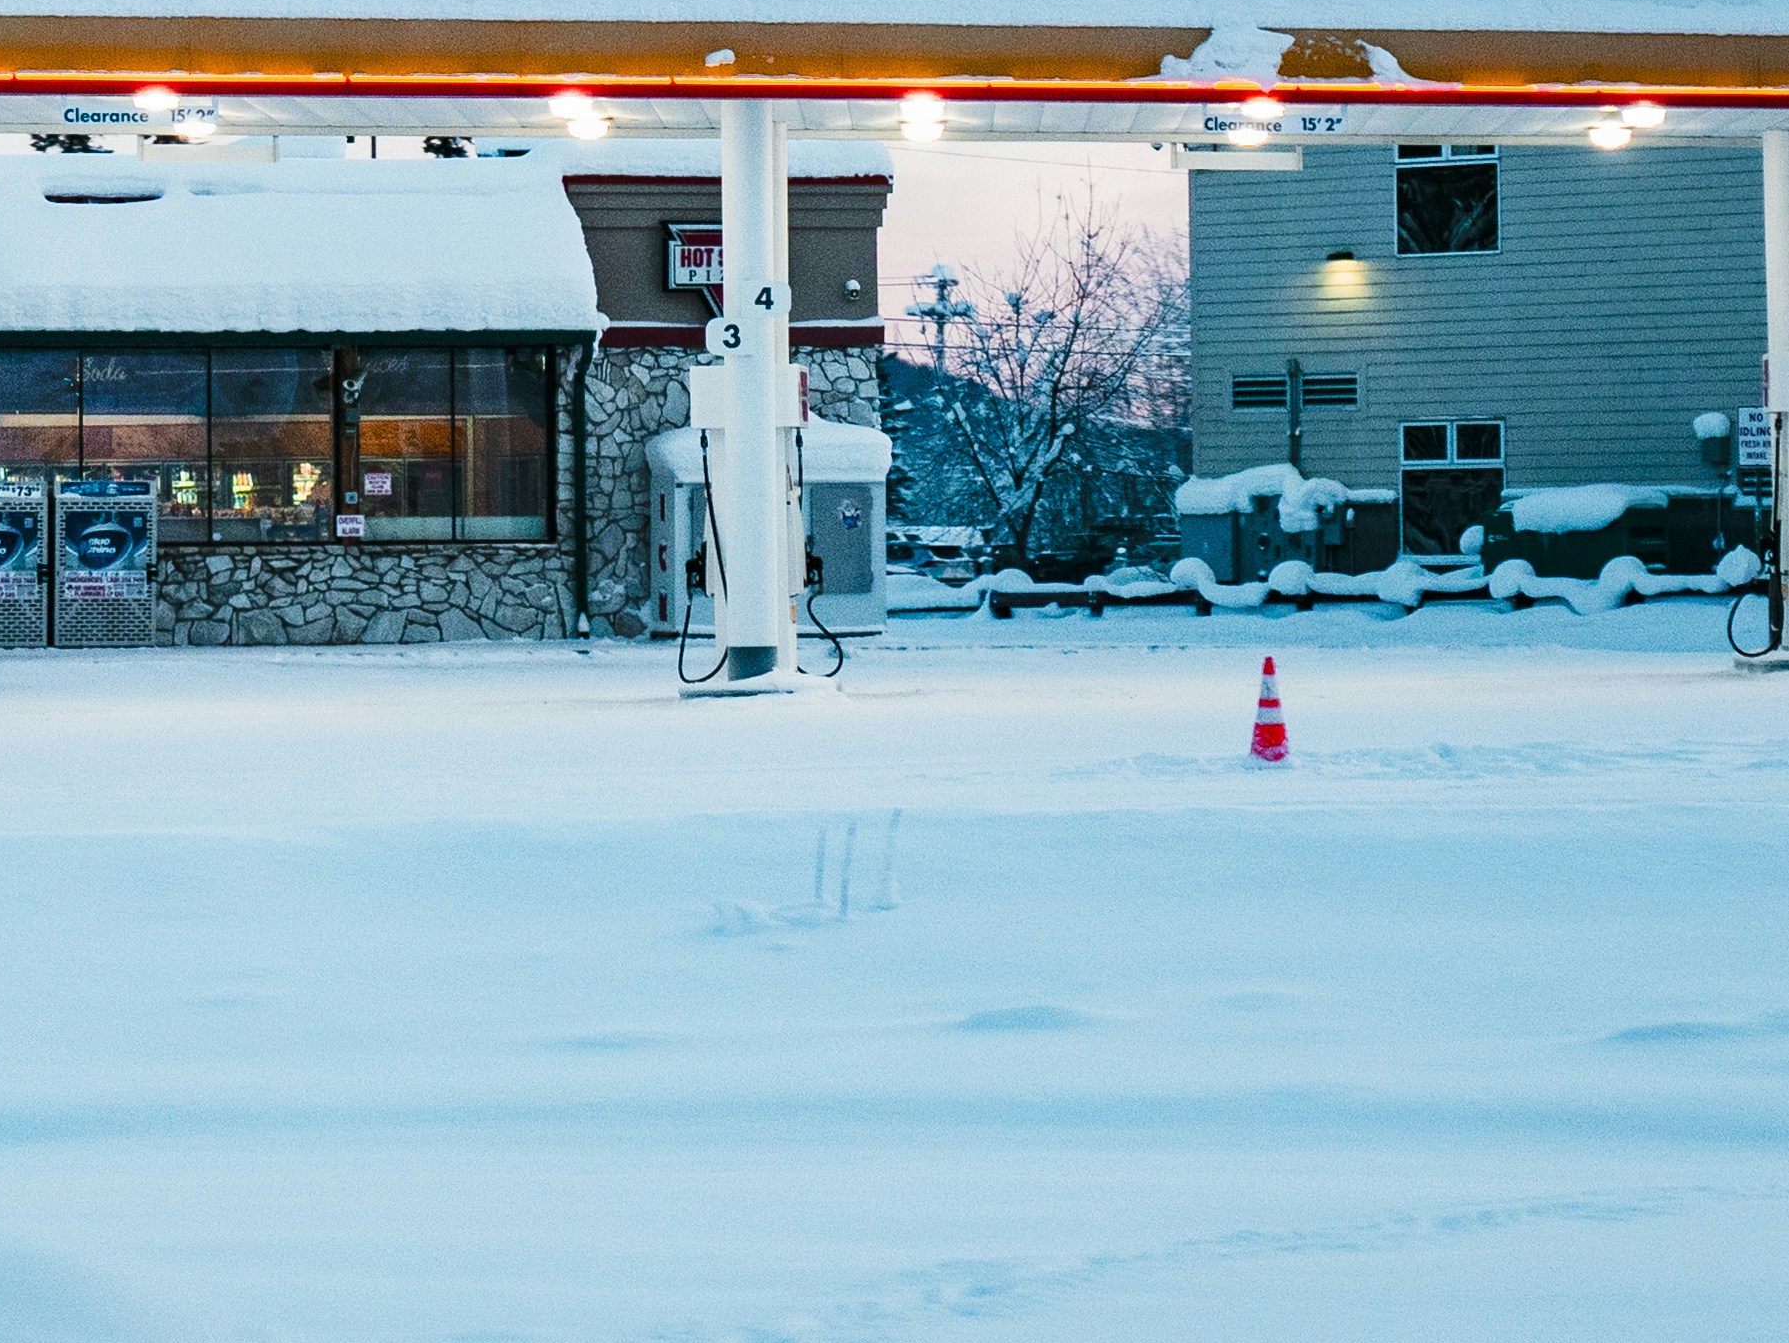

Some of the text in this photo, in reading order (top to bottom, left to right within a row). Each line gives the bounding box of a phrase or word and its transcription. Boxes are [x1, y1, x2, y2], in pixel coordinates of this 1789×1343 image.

[64, 108, 149, 123] Clearance
[681, 248, 714, 268] HOT
[754, 287, 774, 310] 4
[723, 324, 741, 349] 3
[1749, 412, 1763, 423] NO
